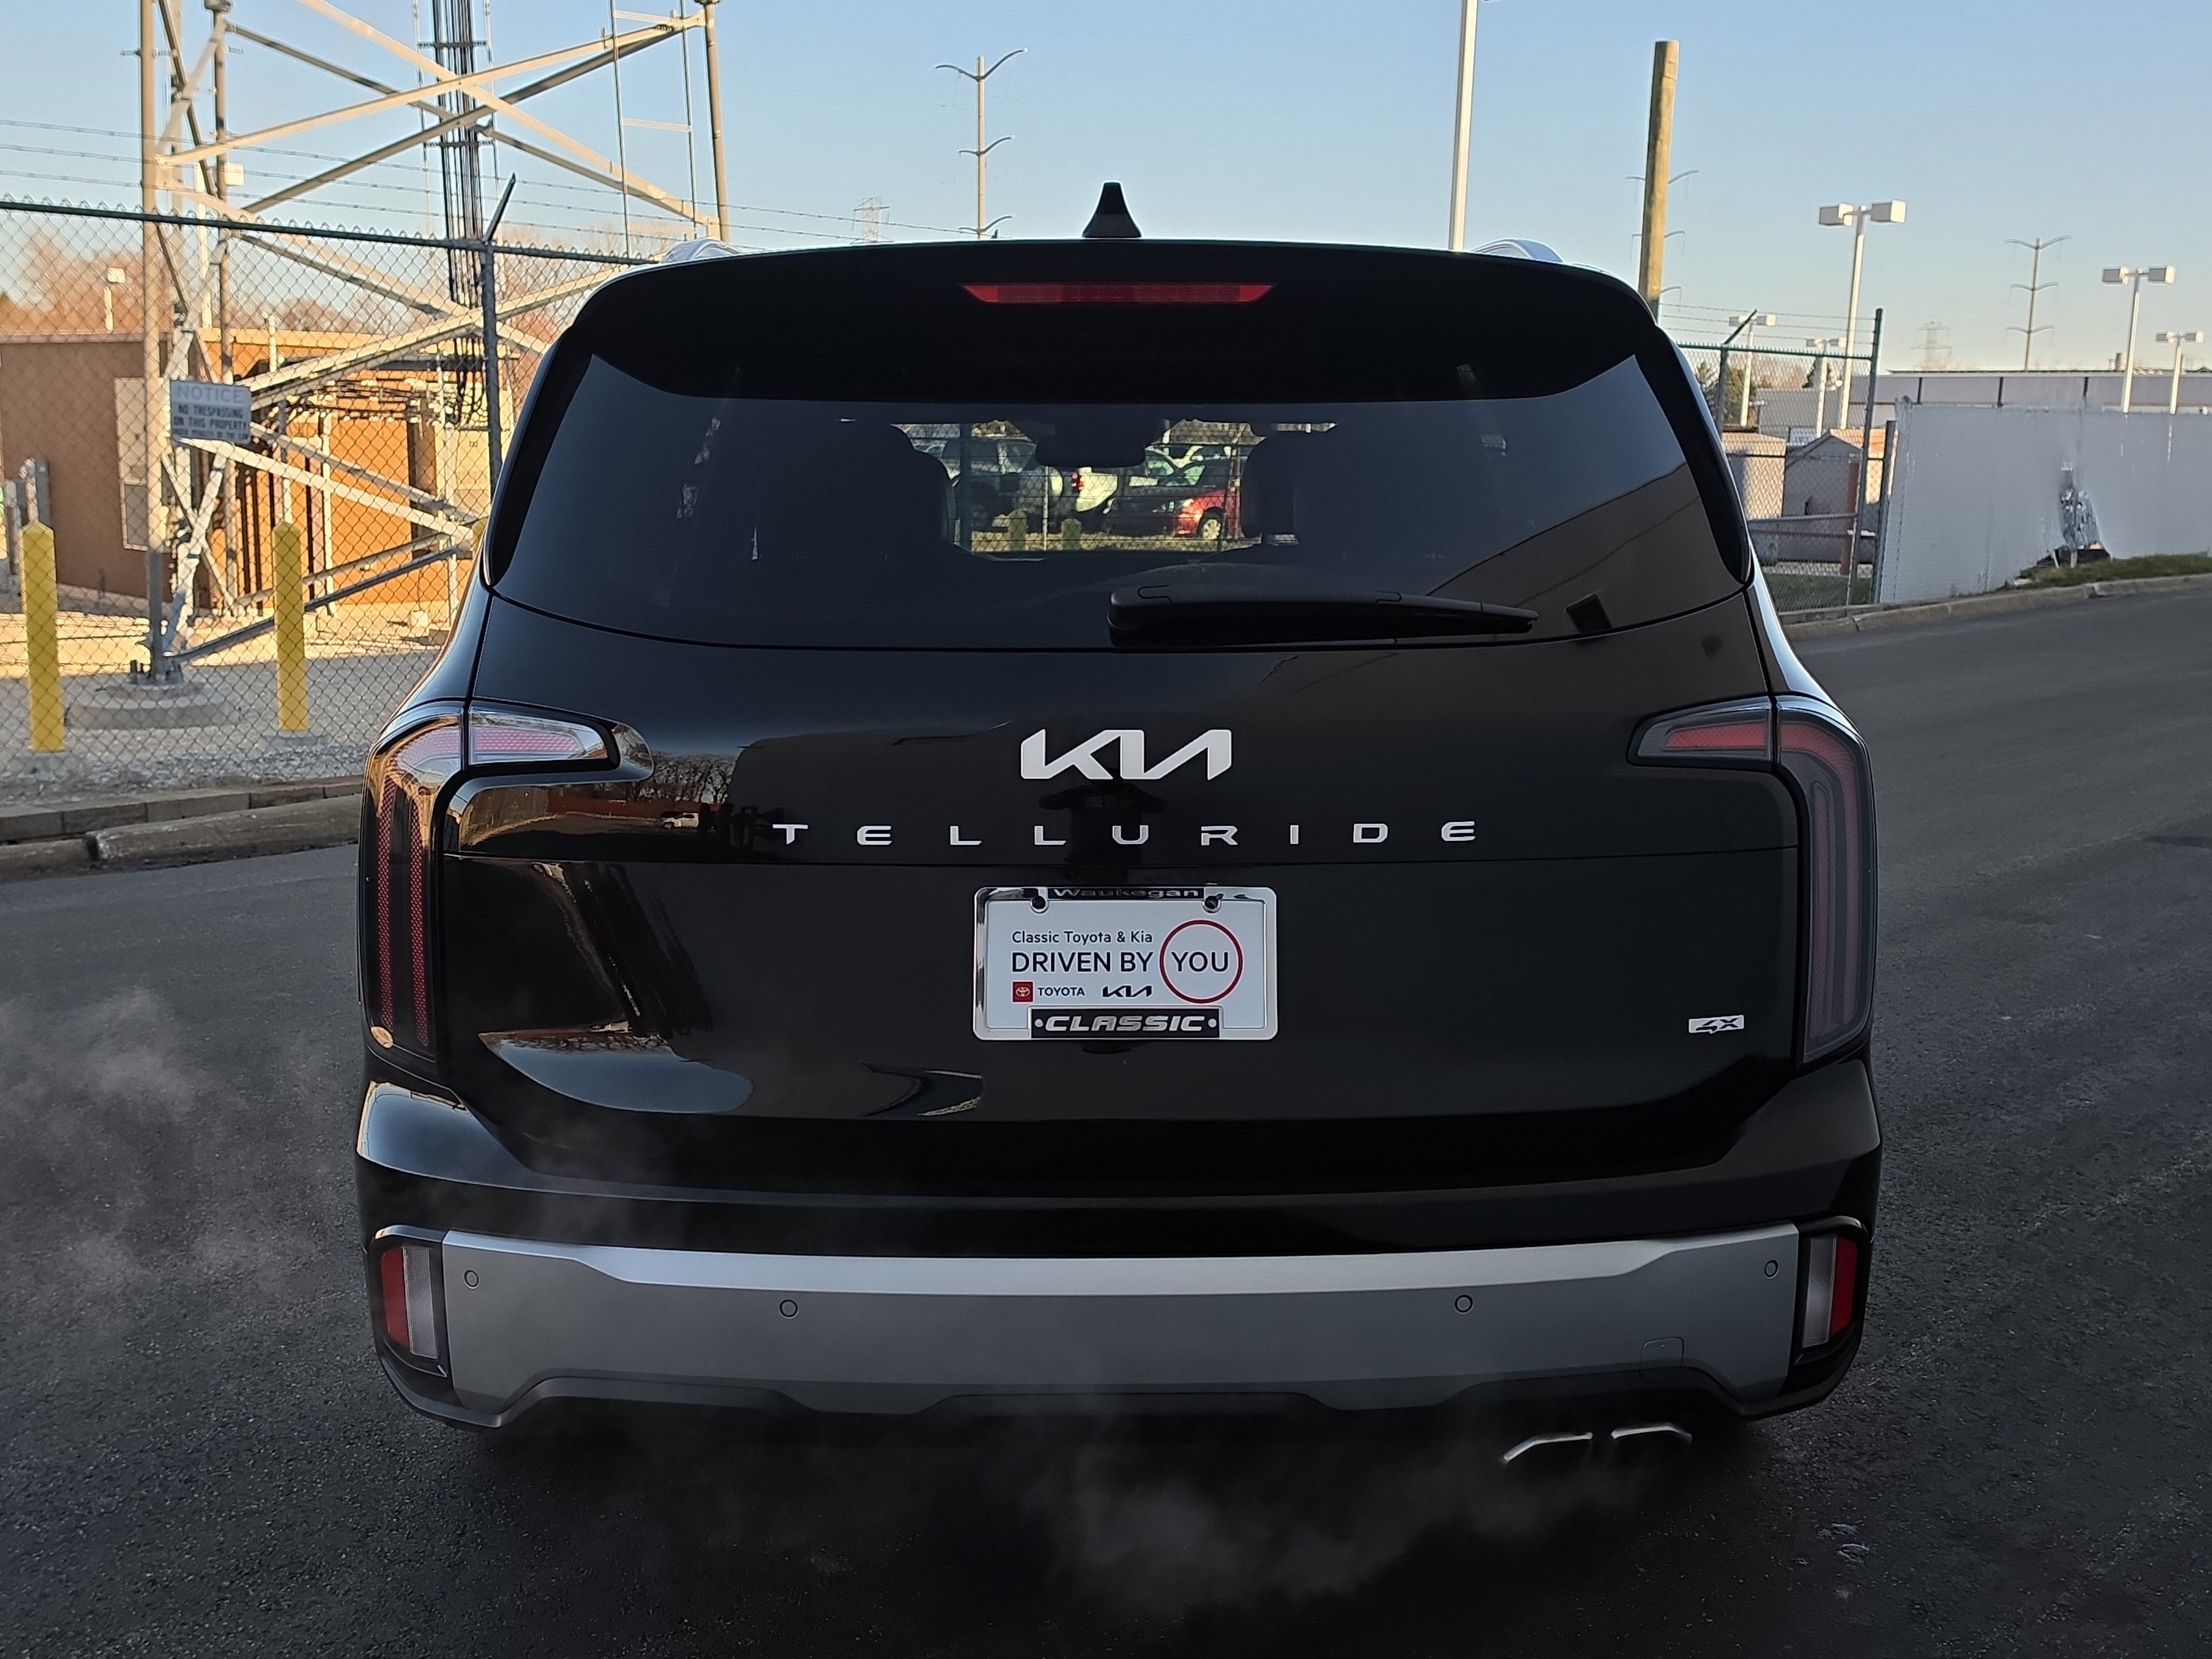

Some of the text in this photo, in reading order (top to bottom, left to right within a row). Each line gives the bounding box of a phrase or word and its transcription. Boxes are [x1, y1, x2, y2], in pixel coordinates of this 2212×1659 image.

[177, 385, 243, 404] NOTICE
[1021, 729, 1231, 780] KIA
[773, 821, 1476, 845] TELLURIDE
[1053, 889, 1199, 898] Waukegan
[1012, 931, 1152, 946] Classic Toyota & Kia
[1012, 951, 1228, 972] DRIVEN BY YOU
[1037, 985, 1152, 997] TOYOTA KIA
[1045, 1015, 1205, 1031] CLASSIC
